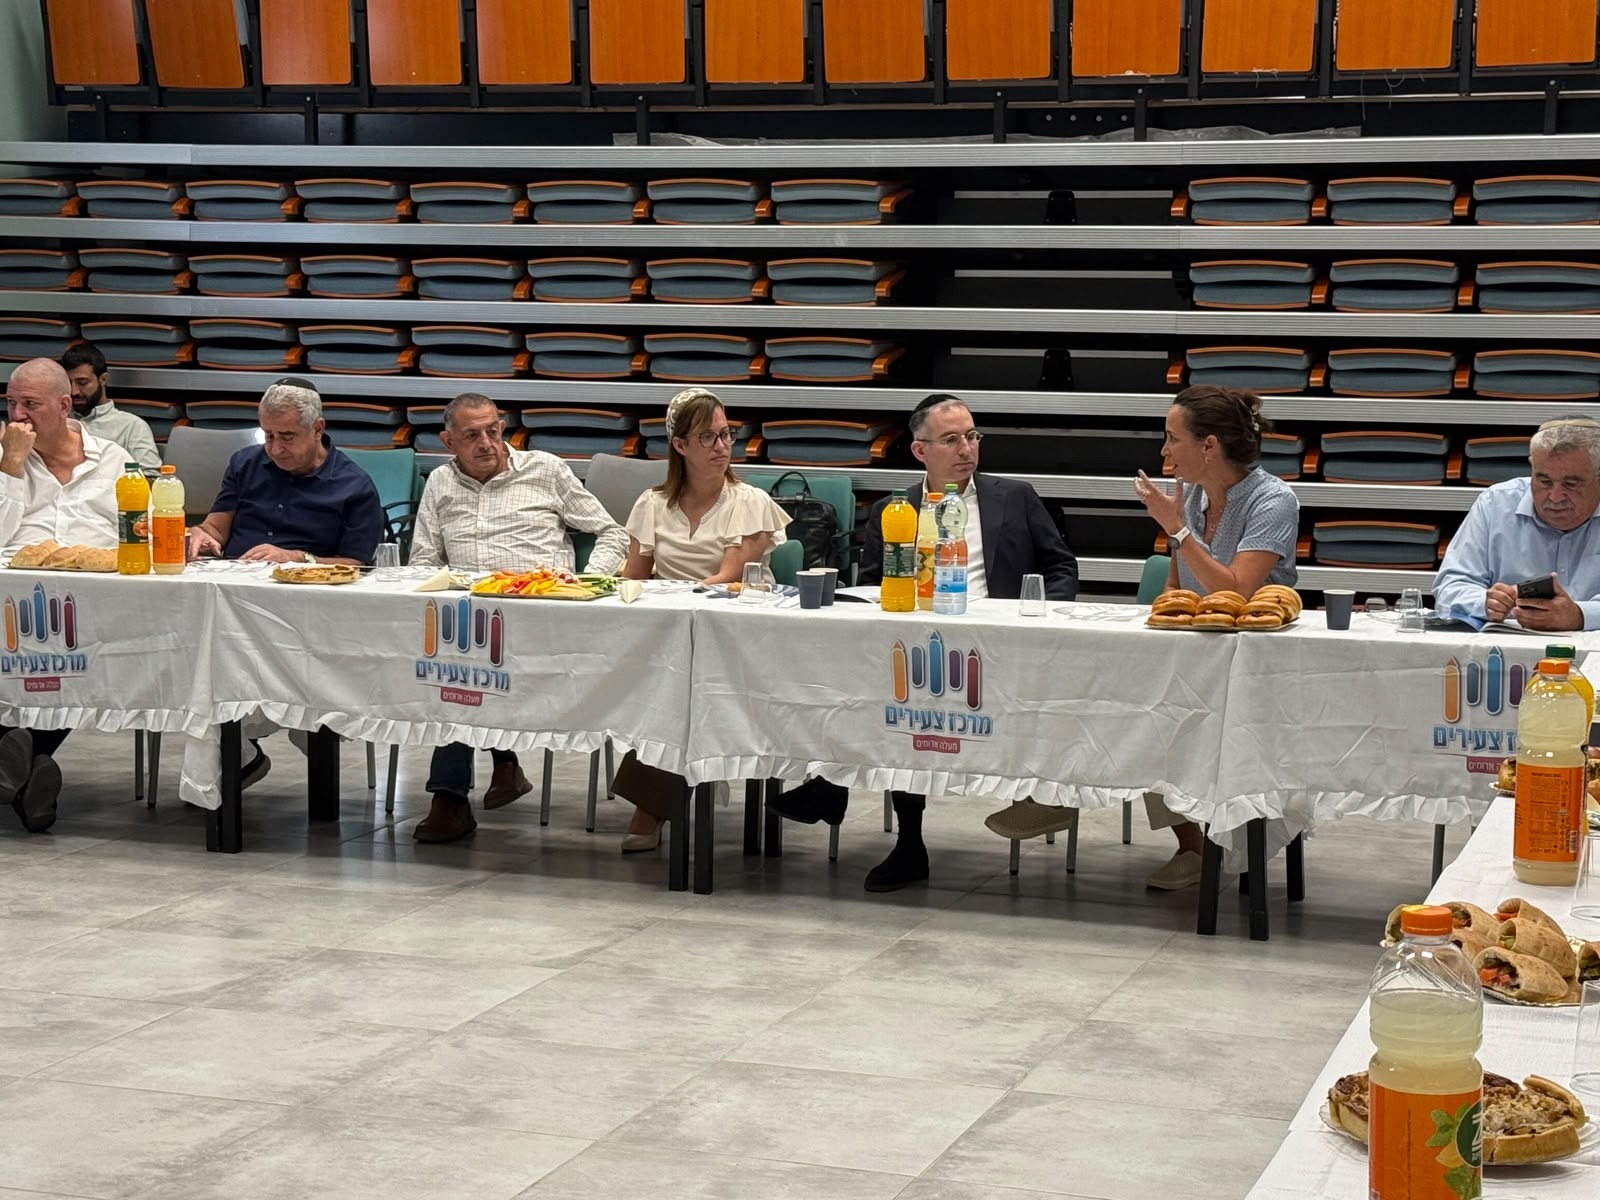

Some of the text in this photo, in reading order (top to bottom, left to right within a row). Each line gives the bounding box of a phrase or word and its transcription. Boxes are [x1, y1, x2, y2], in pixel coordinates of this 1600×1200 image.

[1, 654, 87, 674] מרכז צעירים
[415, 660, 511, 692] מרכז צעירים
[885, 705, 992, 736] מרכז צעירים
[1433, 726, 1503, 752] צעירים
[1468, 761, 1494, 771] אדומים
